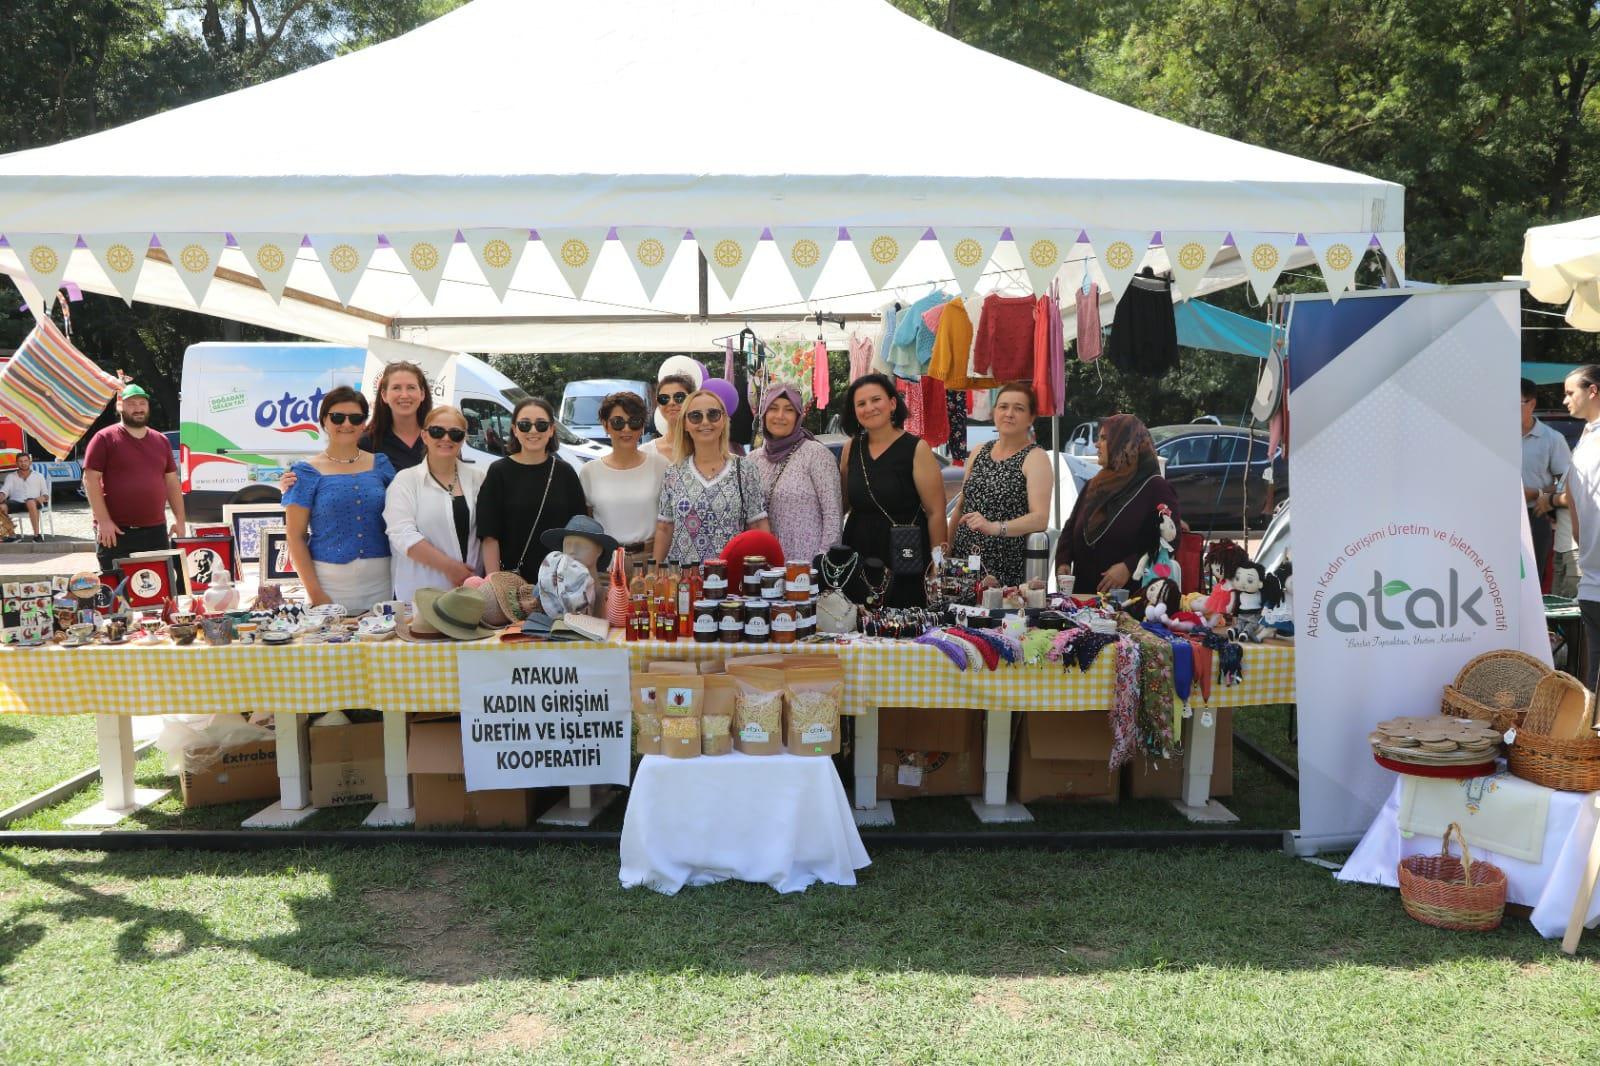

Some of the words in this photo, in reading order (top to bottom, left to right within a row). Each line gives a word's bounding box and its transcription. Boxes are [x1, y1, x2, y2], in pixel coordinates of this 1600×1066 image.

[254, 387, 326, 427] otat
[1306, 590, 1324, 638] Atakum
[1319, 556, 1346, 588] Kadın
[1344, 528, 1386, 557] Girişimi
[1388, 523, 1430, 536] Üretim
[1433, 529, 1447, 541] ve
[1449, 531, 1484, 567] İşletme
[1481, 565, 1509, 631] Kooperatifi
[1326, 568, 1487, 633] atak
[511, 667, 579, 685] ATAKUM
[483, 695, 536, 714] KADIN
[541, 689, 609, 716] GİRİŞİMİ
[472, 718, 534, 742] ÜRETİM
[536, 722, 556, 740] VE
[560, 717, 624, 742] İŞLETME
[496, 744, 601, 770] KOOPERATİFİ
